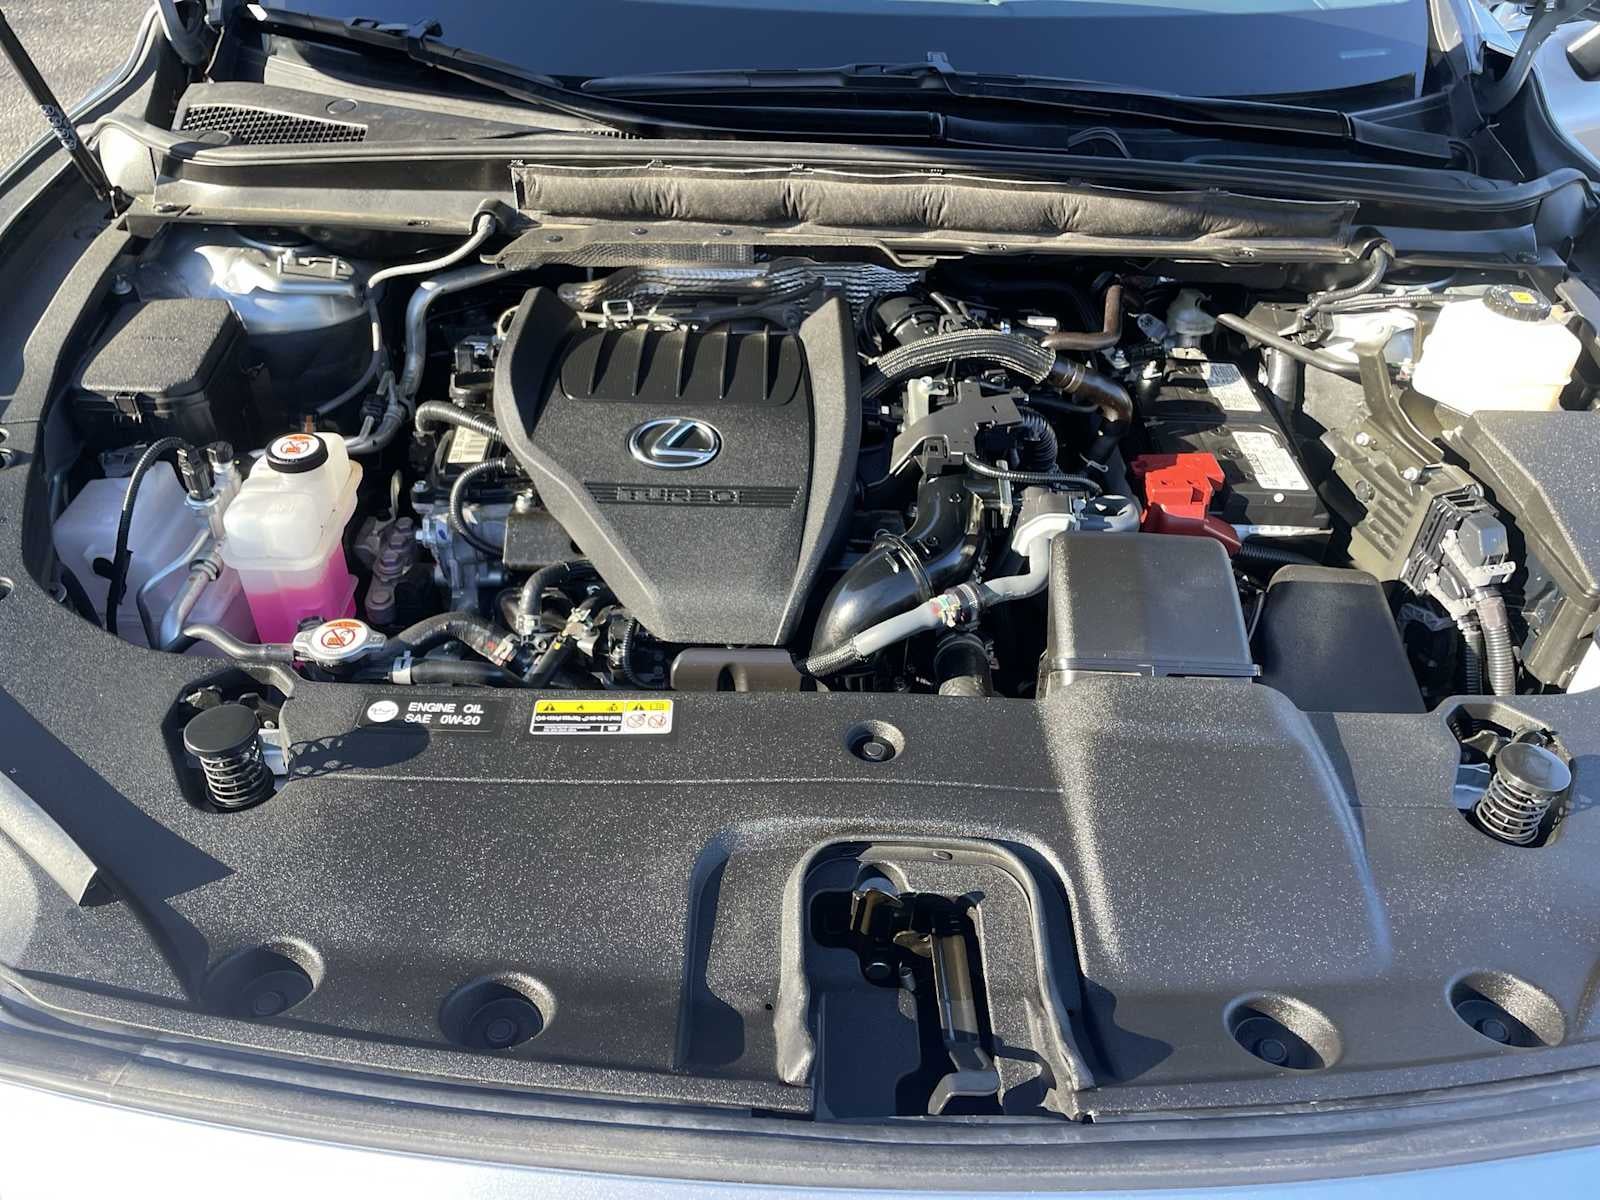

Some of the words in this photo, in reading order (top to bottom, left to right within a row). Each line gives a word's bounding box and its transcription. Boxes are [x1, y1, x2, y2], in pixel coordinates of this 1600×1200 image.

[616, 486, 740, 504] TURBO
[408, 702, 456, 713] ENGINE
[463, 704, 484, 713] OIL
[404, 714, 432, 724] SAE
[440, 715, 480, 725] 0W-20
